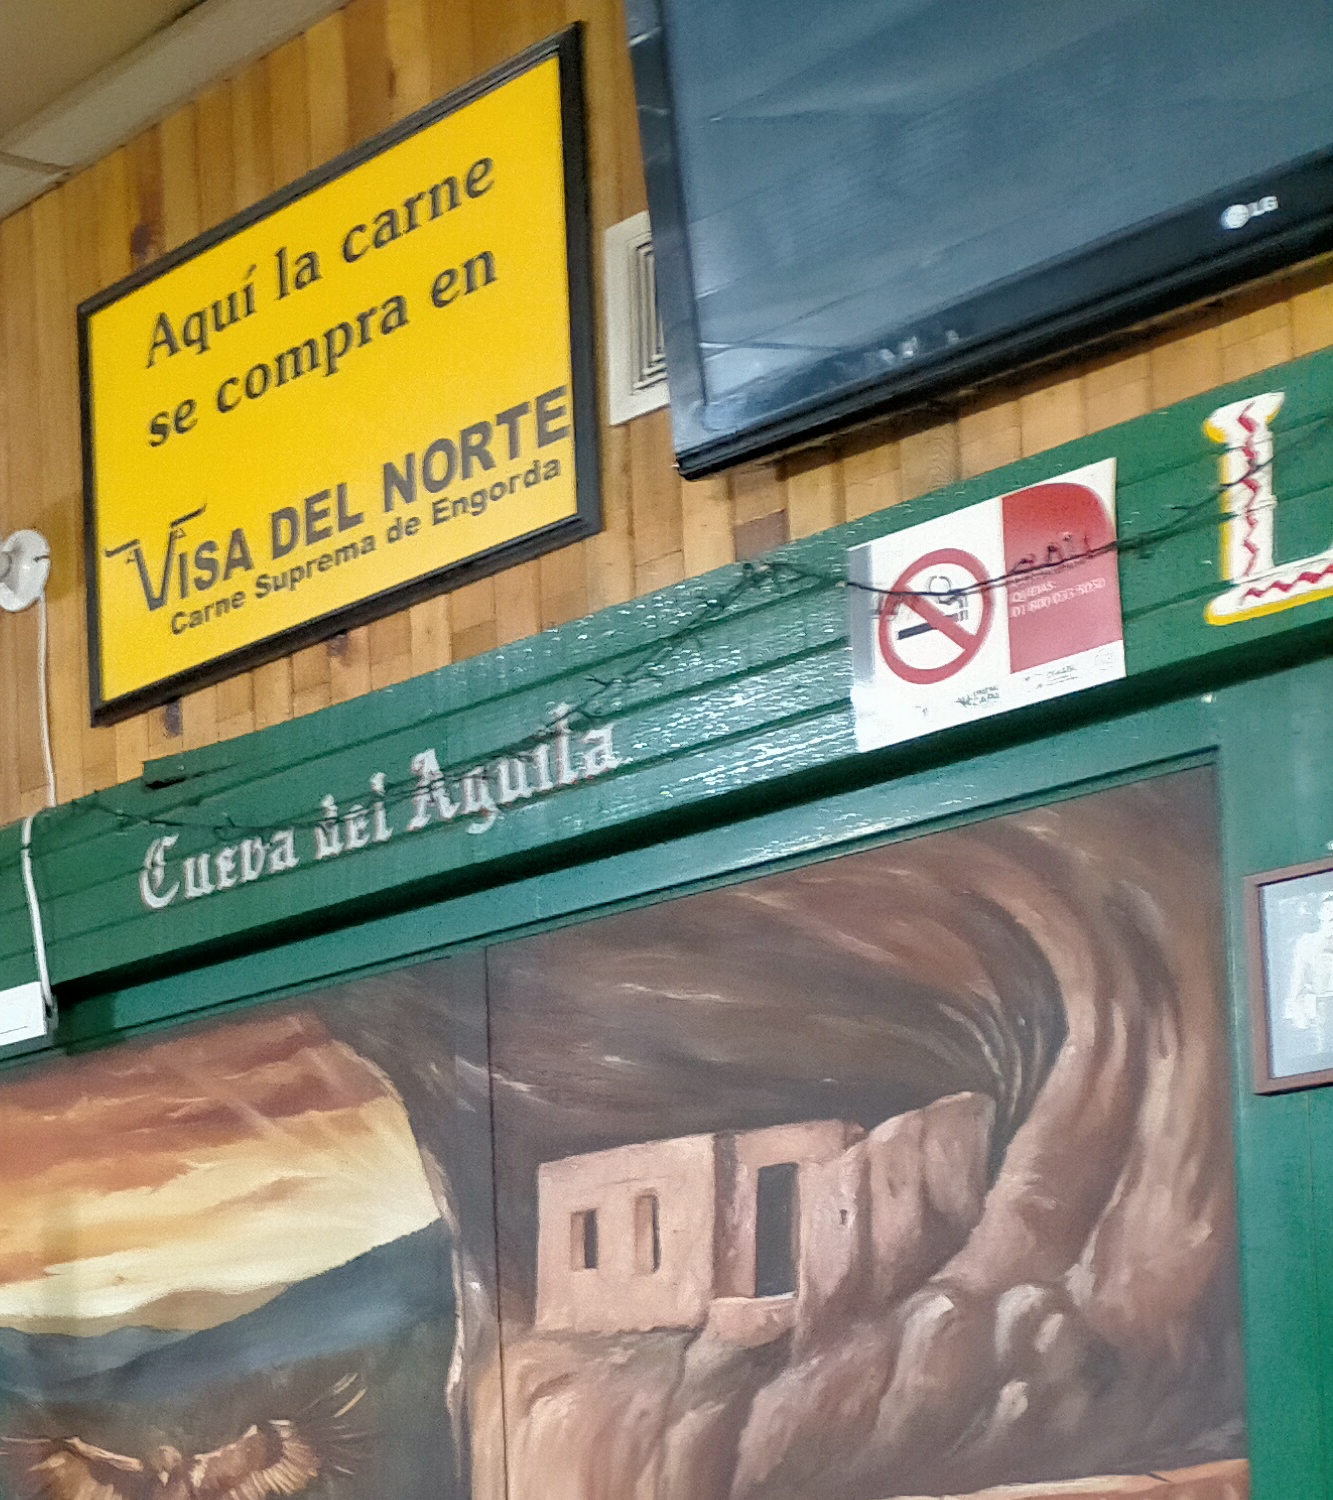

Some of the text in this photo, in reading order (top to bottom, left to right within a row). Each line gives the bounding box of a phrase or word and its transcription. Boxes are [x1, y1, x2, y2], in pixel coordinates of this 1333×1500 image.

[145, 154, 496, 368] Aquí la carne
[148, 249, 499, 447] se compra en
[104, 384, 572, 612] VISA DEL NORTE
[170, 456, 563, 636] Carne Suprema de Engorda
[139, 834, 300, 909] Cueva
